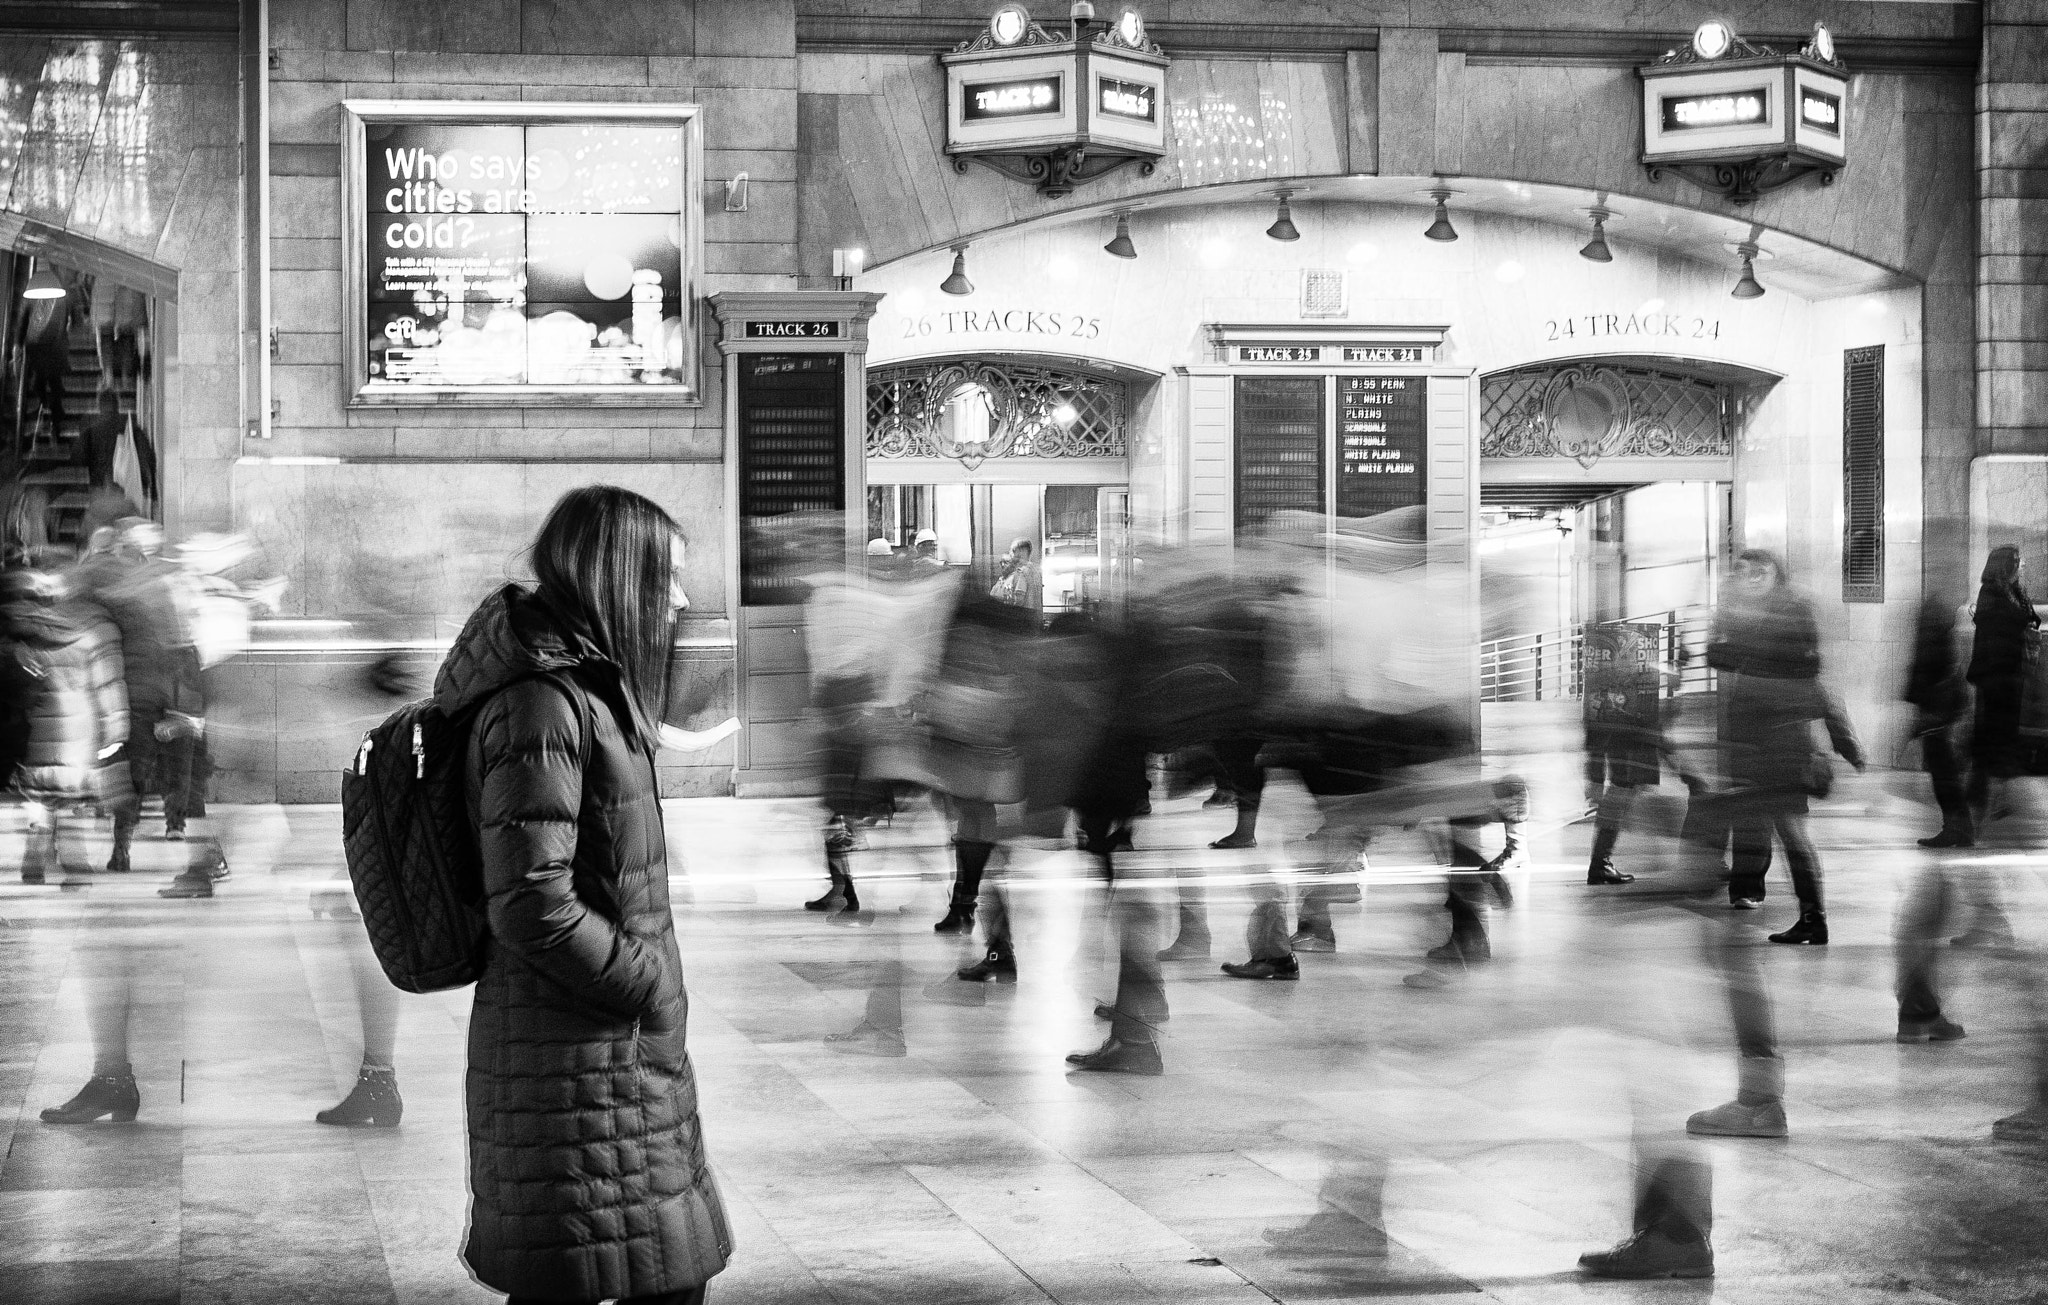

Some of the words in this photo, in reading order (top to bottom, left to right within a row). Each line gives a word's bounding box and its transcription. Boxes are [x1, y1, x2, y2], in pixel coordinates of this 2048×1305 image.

[976, 87, 1031, 110] TRACK
[1103, 90, 1137, 113] TRACK
[1674, 99, 1735, 122] TRACK
[385, 147, 458, 179] Who
[469, 154, 541, 186] says
[385, 180, 473, 213] cities
[483, 188, 537, 213] are
[385, 216, 474, 249] cold?
[384, 316, 417, 339] citi
[755, 323, 806, 336] TRACK
[813, 323, 829, 336] 26
[900, 315, 932, 339] 26
[941, 310, 1062, 335] TRACKS
[1070, 316, 1101, 340] 25
[1544, 318, 1574, 341] 24
[1583, 313, 1681, 336] TRACK
[1692, 318, 1721, 340] 24
[1248, 347, 1292, 361] TRACK
[1297, 347, 1312, 361] 25
[1351, 348, 1394, 361] TRACK
[1400, 348, 1415, 361] 24
[1381, 378, 1406, 389] PEAK
[1363, 393, 1394, 404] WHITE
[1345, 408, 1382, 419] PLAINS
